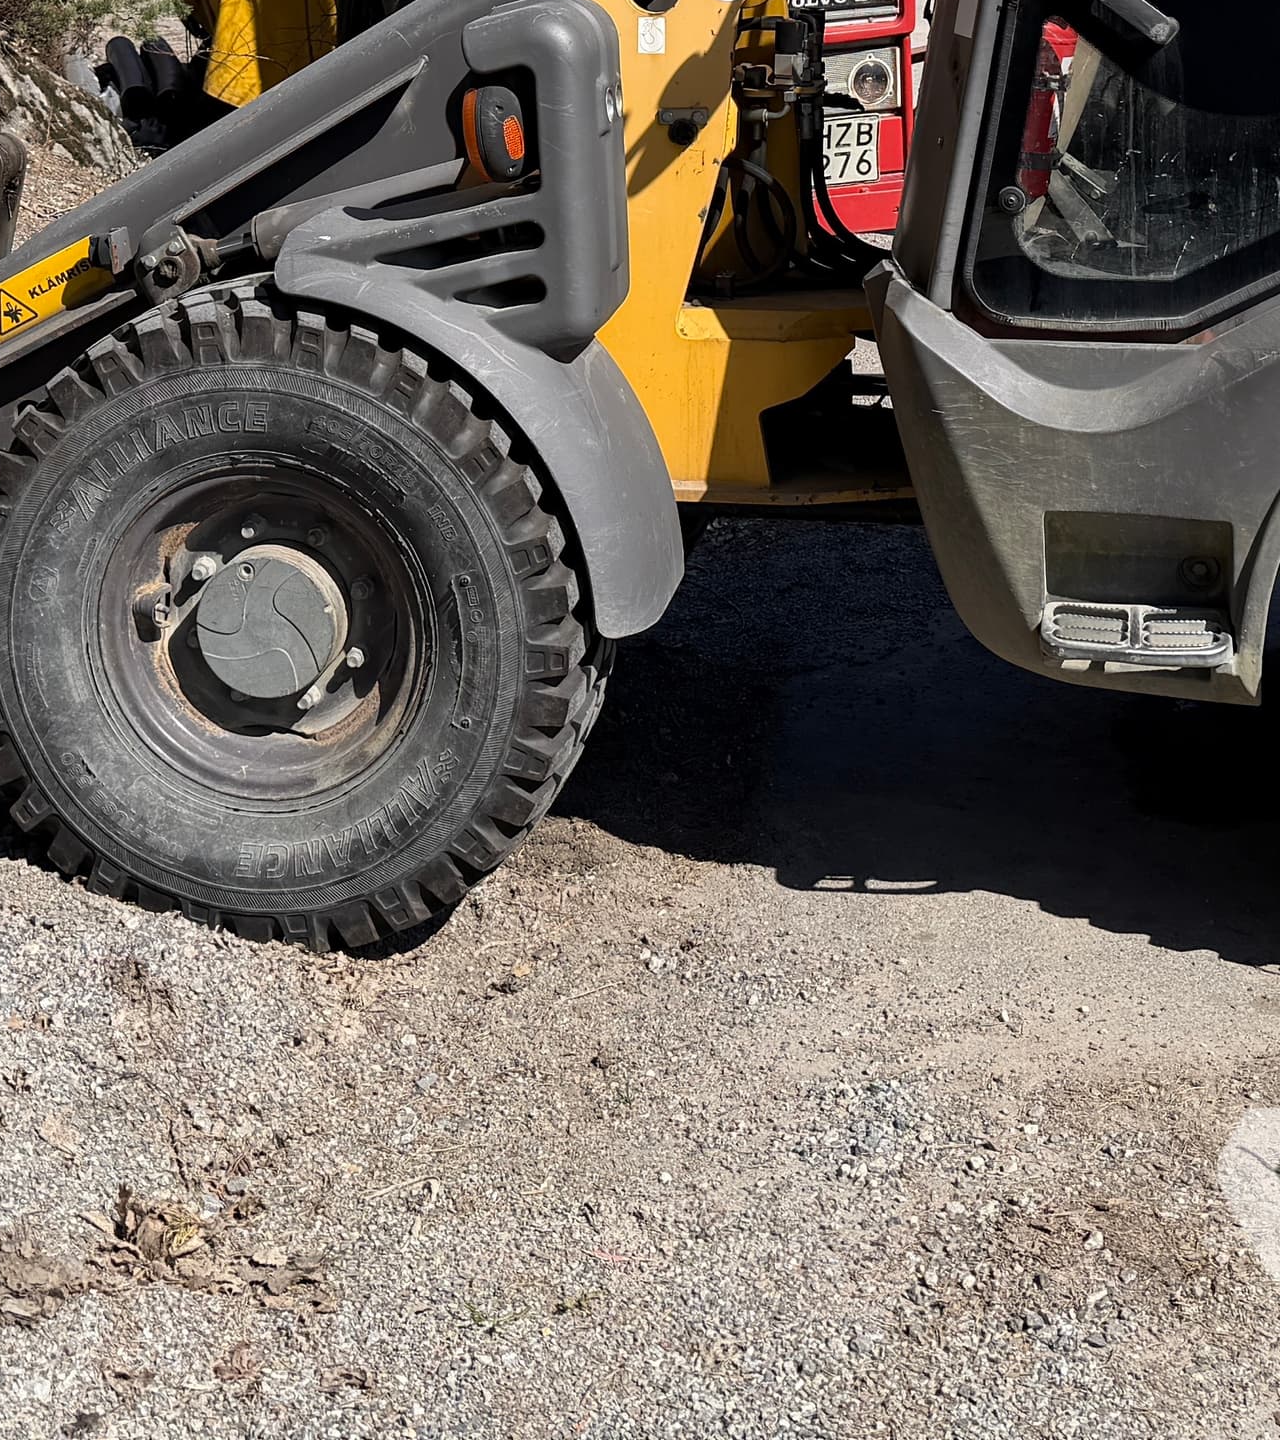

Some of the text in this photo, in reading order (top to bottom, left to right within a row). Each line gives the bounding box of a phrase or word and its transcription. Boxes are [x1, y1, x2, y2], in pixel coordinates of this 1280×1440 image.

[28, 257, 93, 299] KLÄMRIS
[70, 401, 270, 522] ALLIANCE
[234, 759, 440, 879] ALLIANCE
